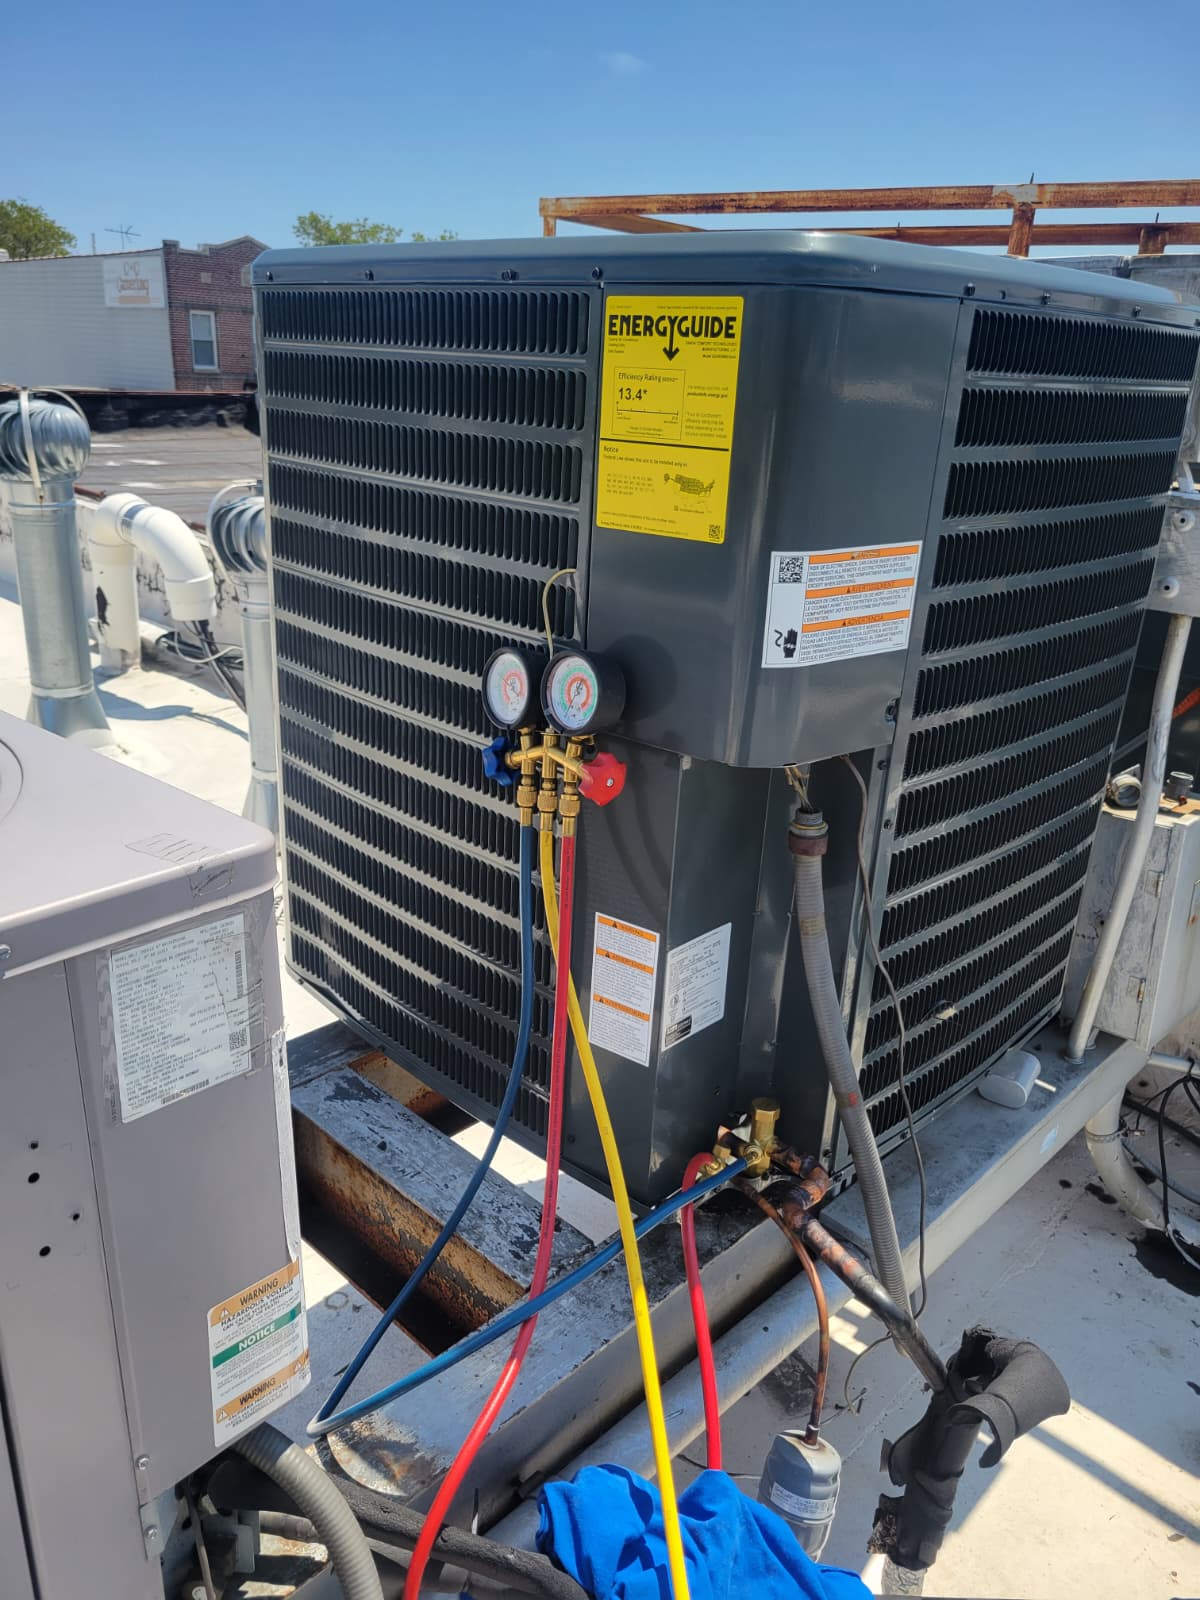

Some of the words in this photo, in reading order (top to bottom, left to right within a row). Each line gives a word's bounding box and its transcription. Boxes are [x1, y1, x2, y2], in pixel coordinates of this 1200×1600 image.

[608, 314, 737, 339] ENERGYGUIDE
[618, 372, 643, 382] Efficiency
[644, 374, 661, 383] Rating
[240, 1278, 278, 1305] WARNING
[221, 1297, 264, 1326] HAZARDOUS
[238, 1322, 276, 1351] NOTICE
[239, 1377, 276, 1405] WARNING
